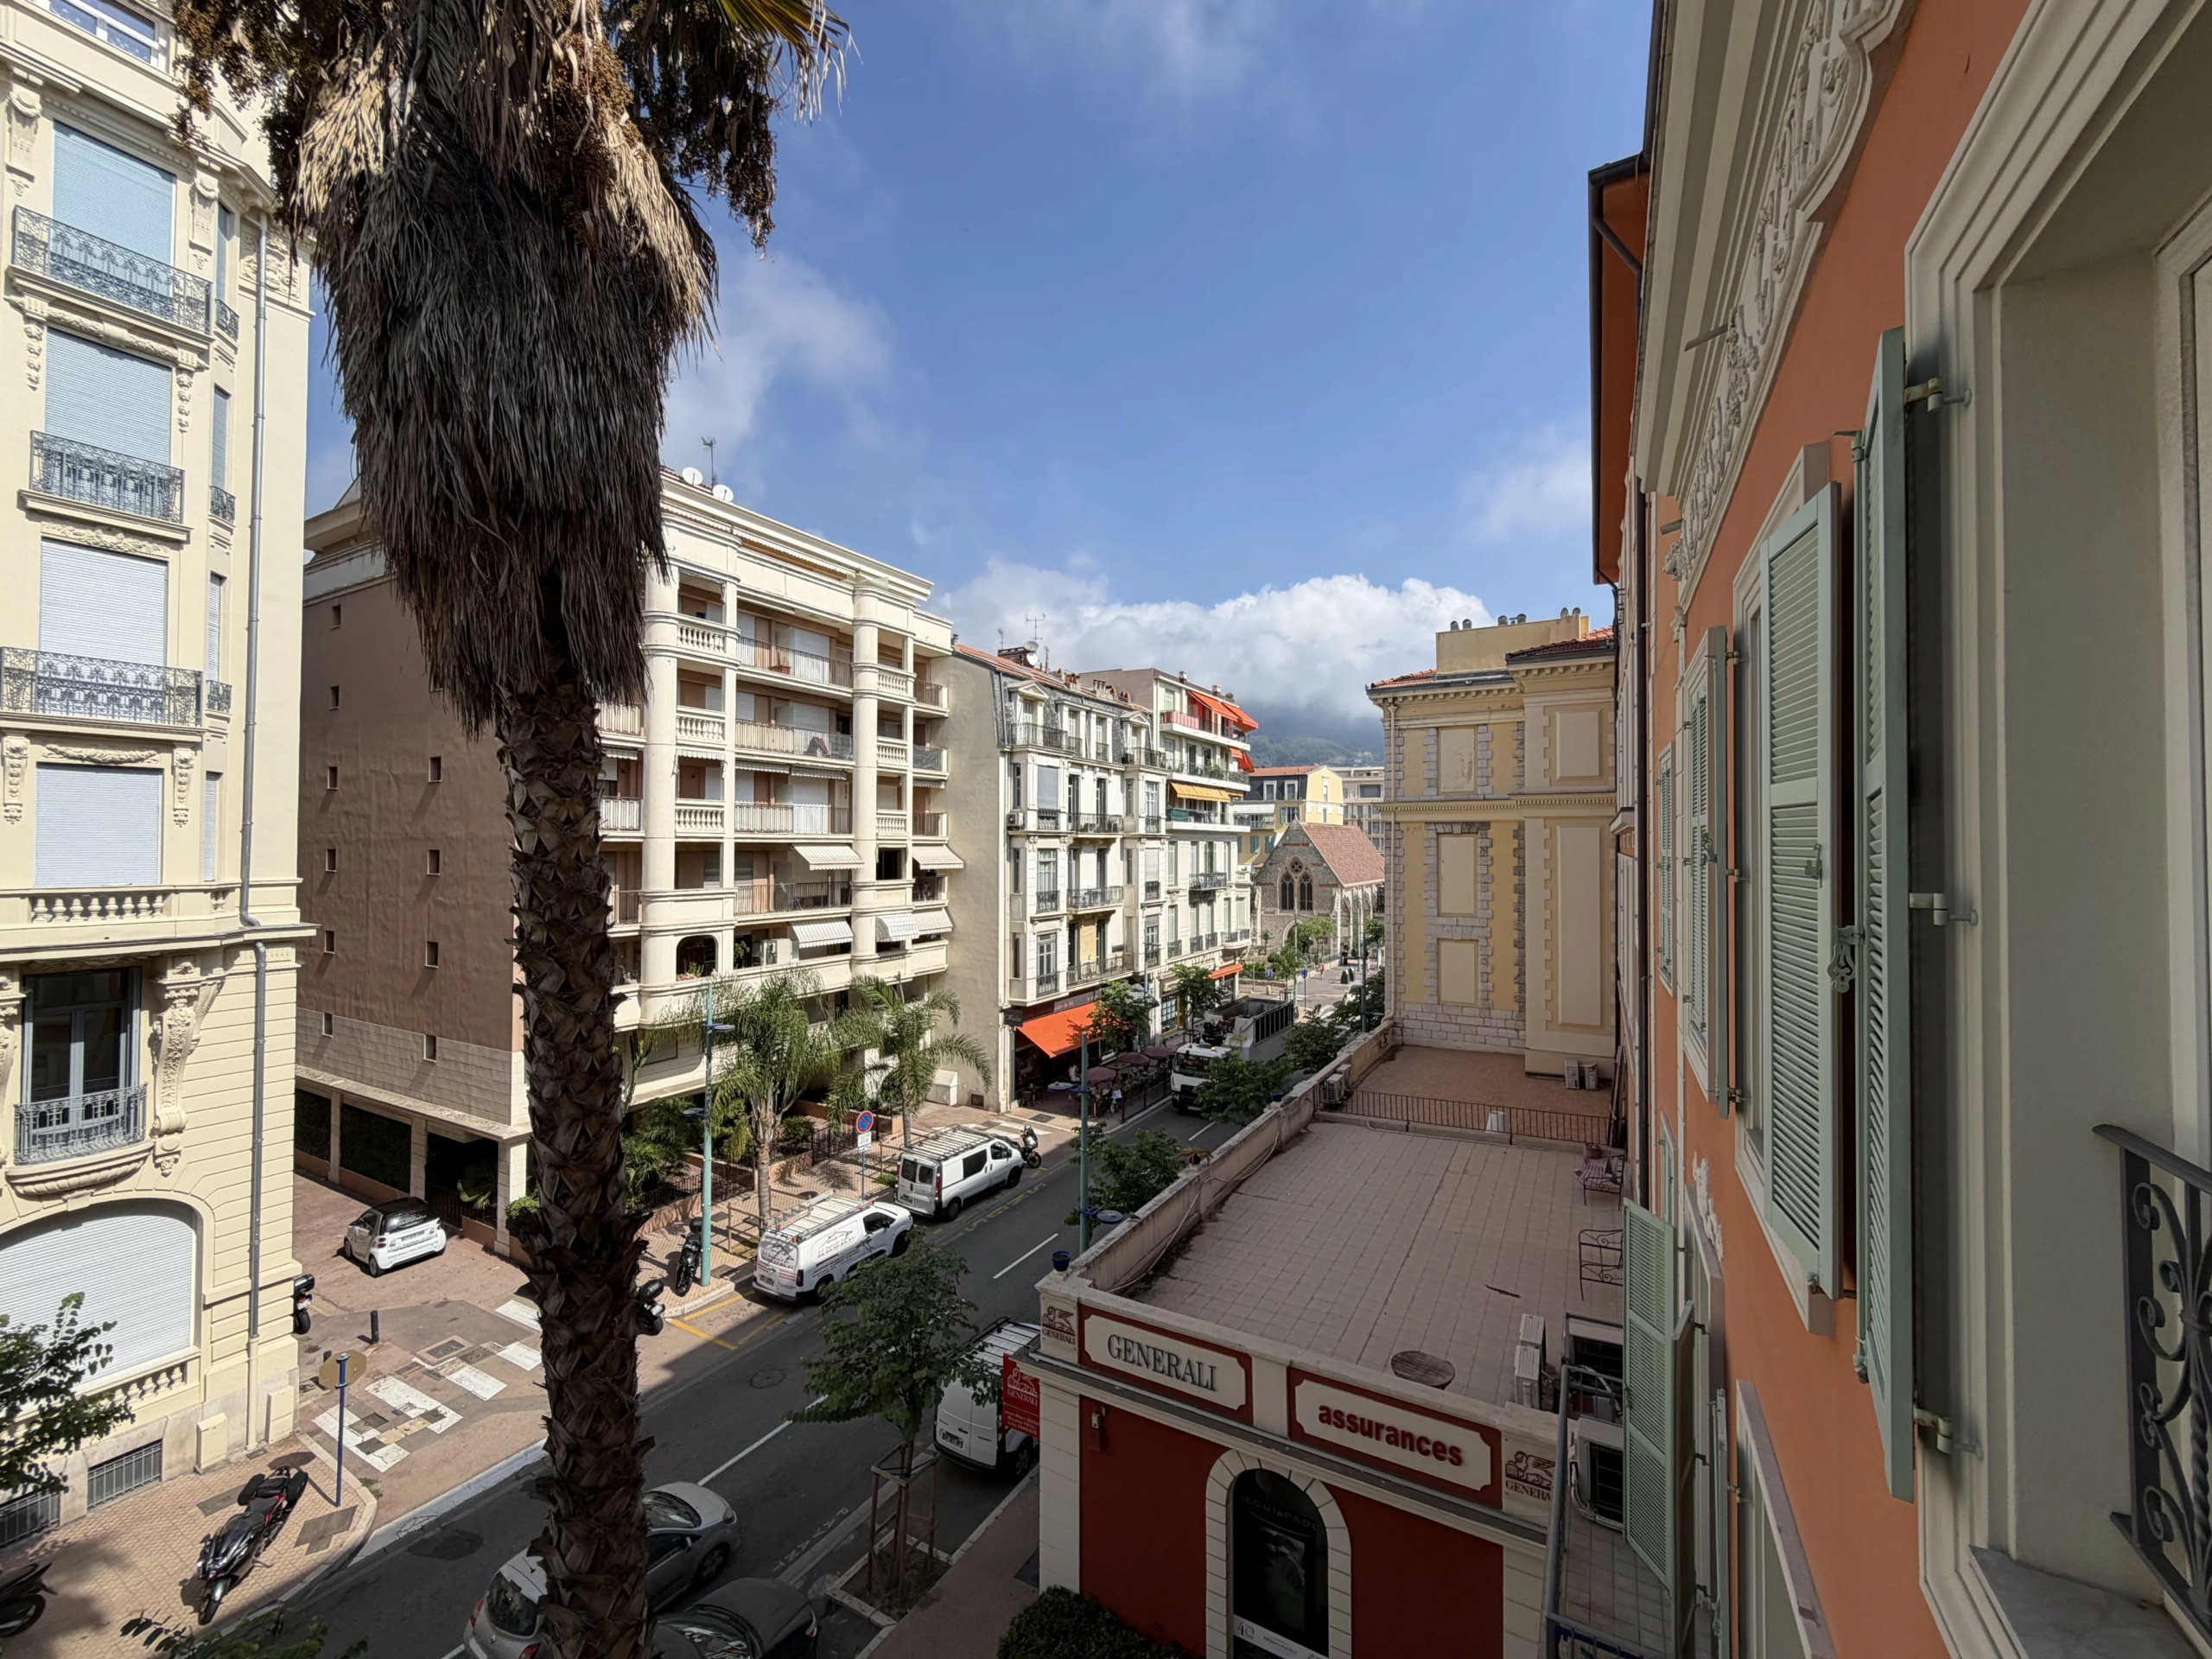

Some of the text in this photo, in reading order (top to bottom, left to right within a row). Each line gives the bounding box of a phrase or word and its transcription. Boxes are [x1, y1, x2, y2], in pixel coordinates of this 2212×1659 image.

[1041, 1328, 1076, 1345] GENERALI
[1107, 1333, 1217, 1392] GENERALI
[1007, 1389, 1039, 1407] GENERALI
[1318, 1404, 1463, 1466] assurances
